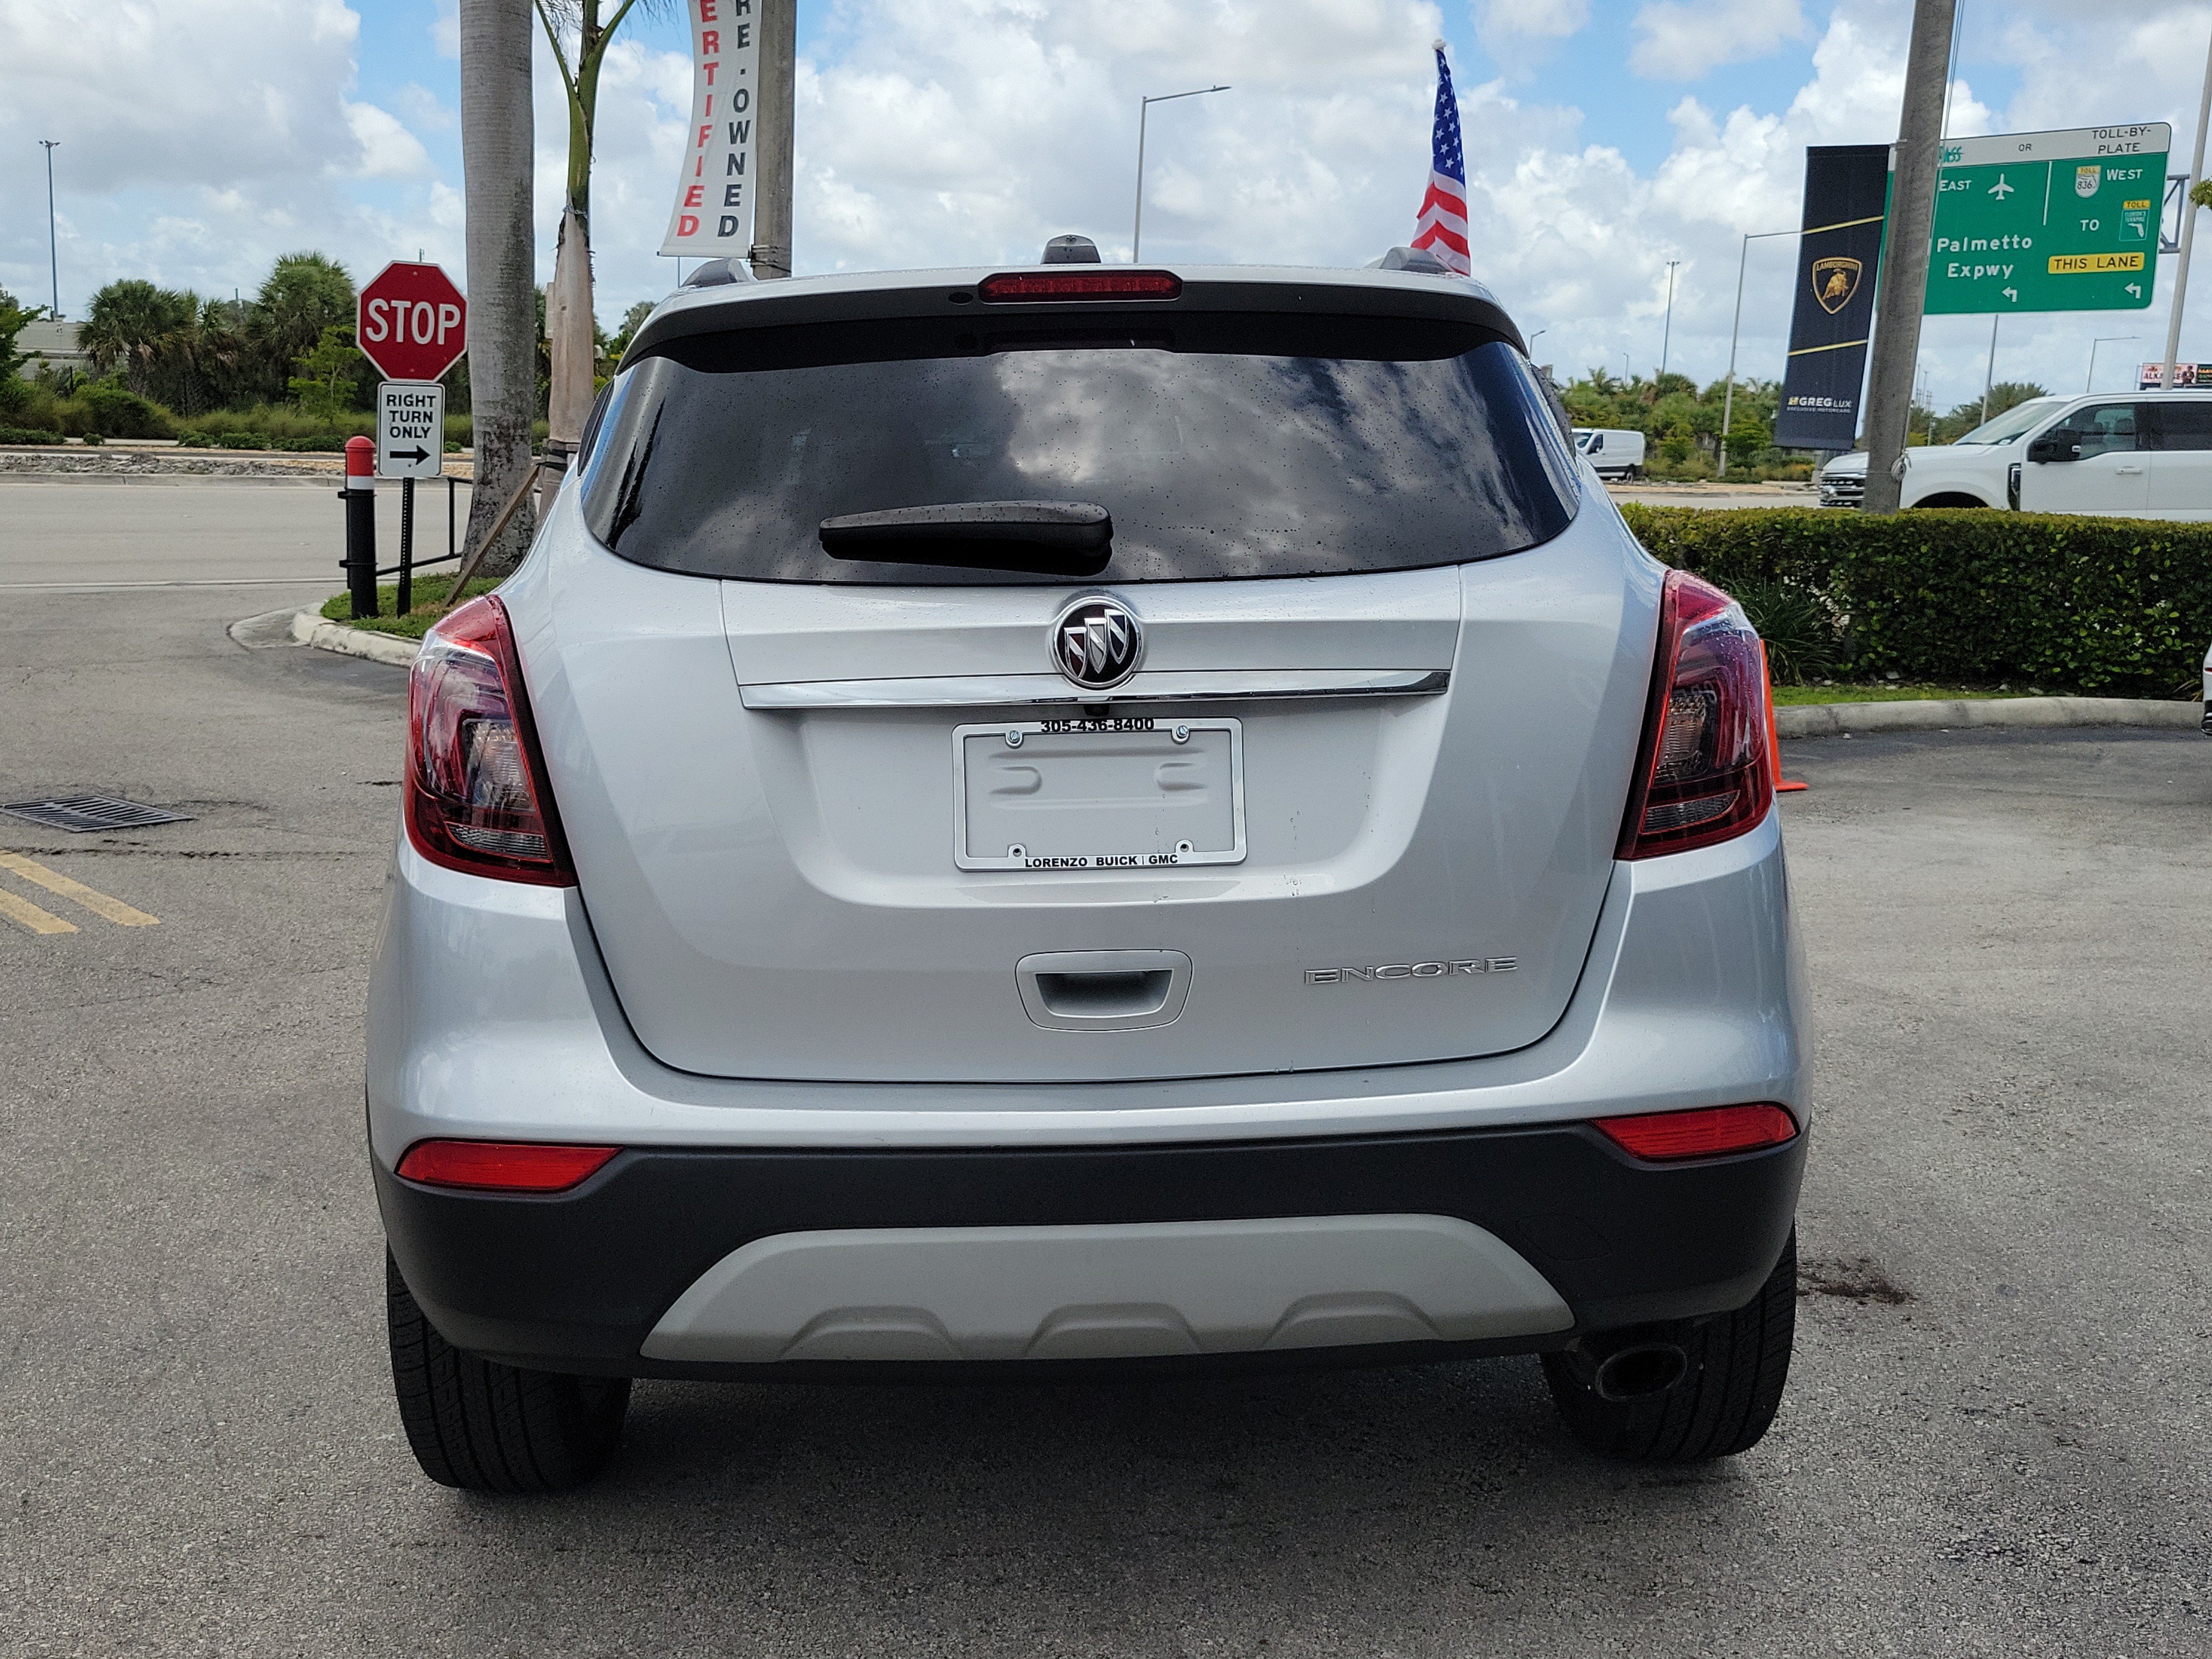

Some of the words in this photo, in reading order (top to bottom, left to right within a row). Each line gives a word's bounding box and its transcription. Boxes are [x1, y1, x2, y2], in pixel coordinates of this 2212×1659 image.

[2018, 143, 2032, 151] OR
[2098, 143, 2140, 154] PLATE
[2107, 168, 2143, 180] WEST
[1939, 179, 1972, 191] EAST
[2077, 181, 2092, 189] 836
[2080, 219, 2100, 231] TO
[1937, 234, 2032, 252] Palmetto
[2054, 258, 2087, 270] THIS
[2096, 256, 2139, 268] LANE
[1948, 262, 2014, 280] Expwy
[365, 298, 461, 345] STOP
[386, 394, 436, 408] RIGHT
[389, 410, 433, 423] TURN
[390, 426, 432, 438] ONLY
[1041, 718, 1154, 733] 305-436-8400
[1024, 857, 1088, 868] LORENZO
[1096, 856, 1138, 866] BUICK
[1148, 854, 1178, 865] GMC
[1304, 956, 1518, 985] ENCORE
